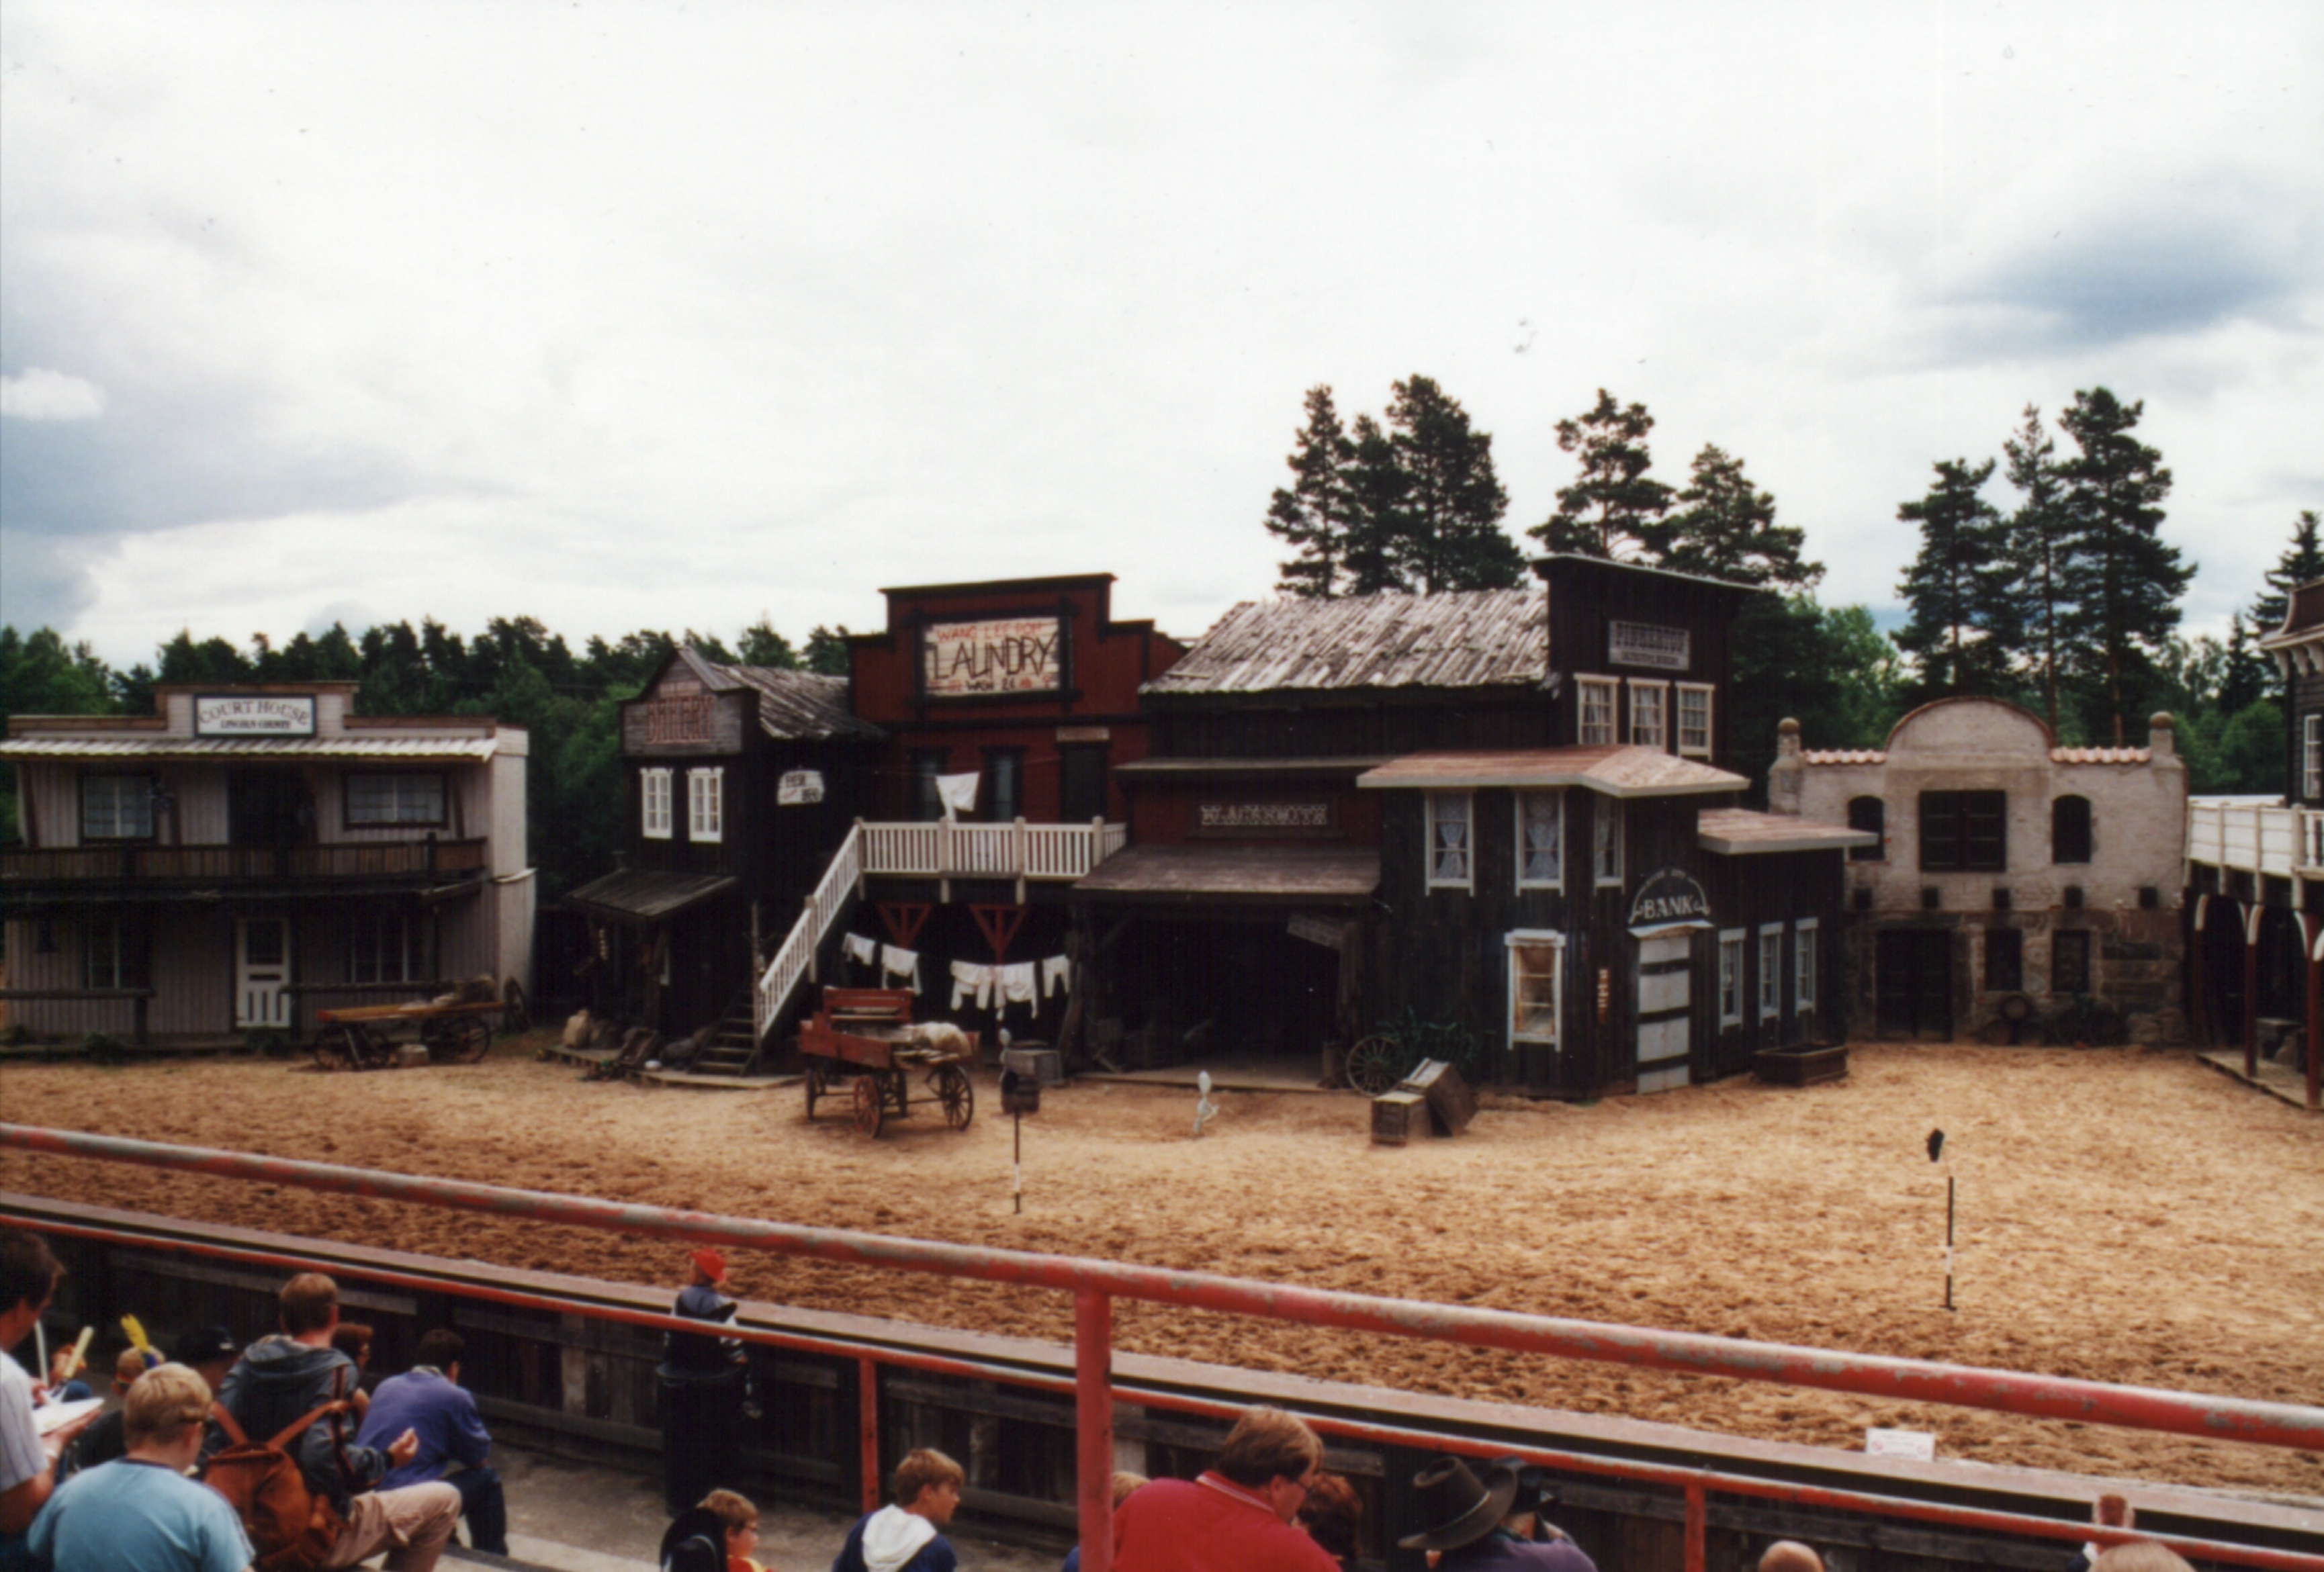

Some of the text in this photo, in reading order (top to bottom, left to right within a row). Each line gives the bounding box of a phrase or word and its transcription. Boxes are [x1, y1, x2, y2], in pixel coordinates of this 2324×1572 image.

[928, 631, 1057, 680] LAUNDRY
[199, 700, 309, 726] COURT HOUSE
[646, 694, 713, 744] BAKERY
[1202, 804, 1328, 826] BLACKSMITH
[1644, 894, 1695, 920] BANK
